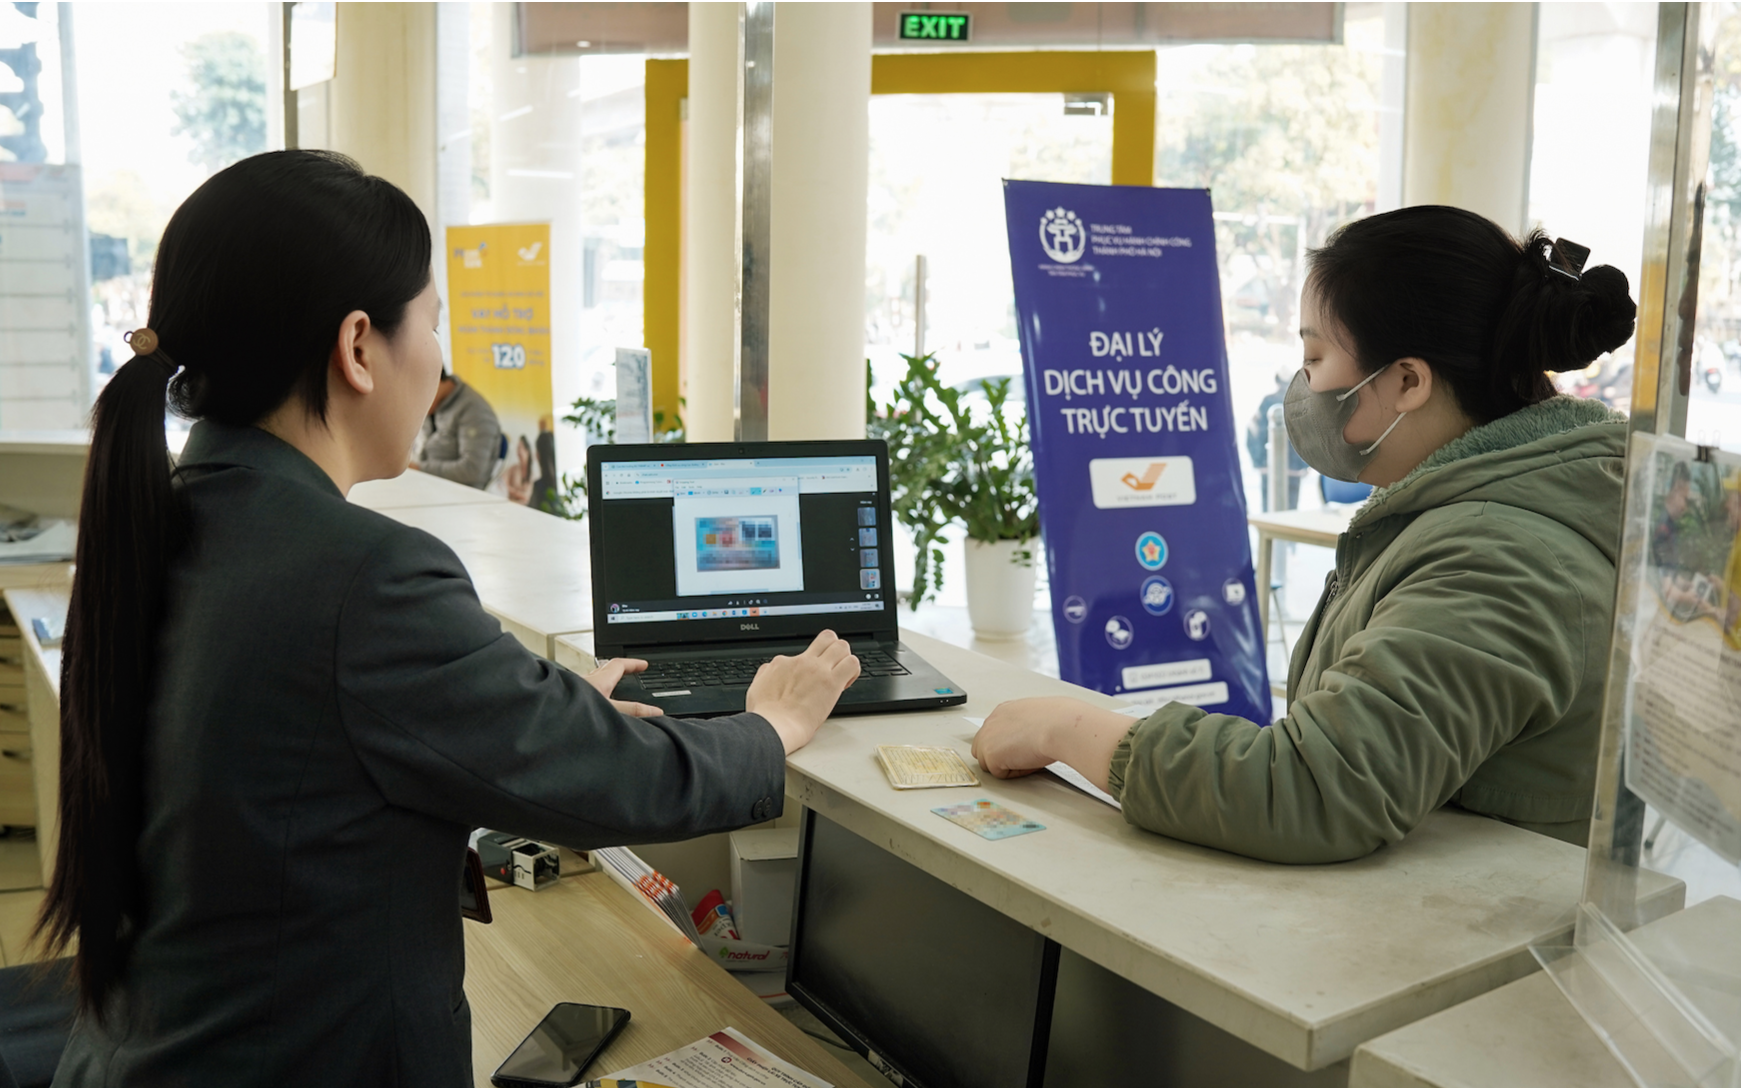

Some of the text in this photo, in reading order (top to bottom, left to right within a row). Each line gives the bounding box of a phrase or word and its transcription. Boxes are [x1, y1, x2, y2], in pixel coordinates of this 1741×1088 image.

[904, 15, 966, 38] EXIT
[491, 343, 526, 369] 120
[1089, 327, 1164, 362] ĐẠI LÝ
[1043, 364, 1218, 401] DỊCH VỤ CÔNG
[1060, 399, 1208, 439] TRỰC TUYẾN
[740, 623, 760, 631] DELL
[727, 950, 771, 961] natural
